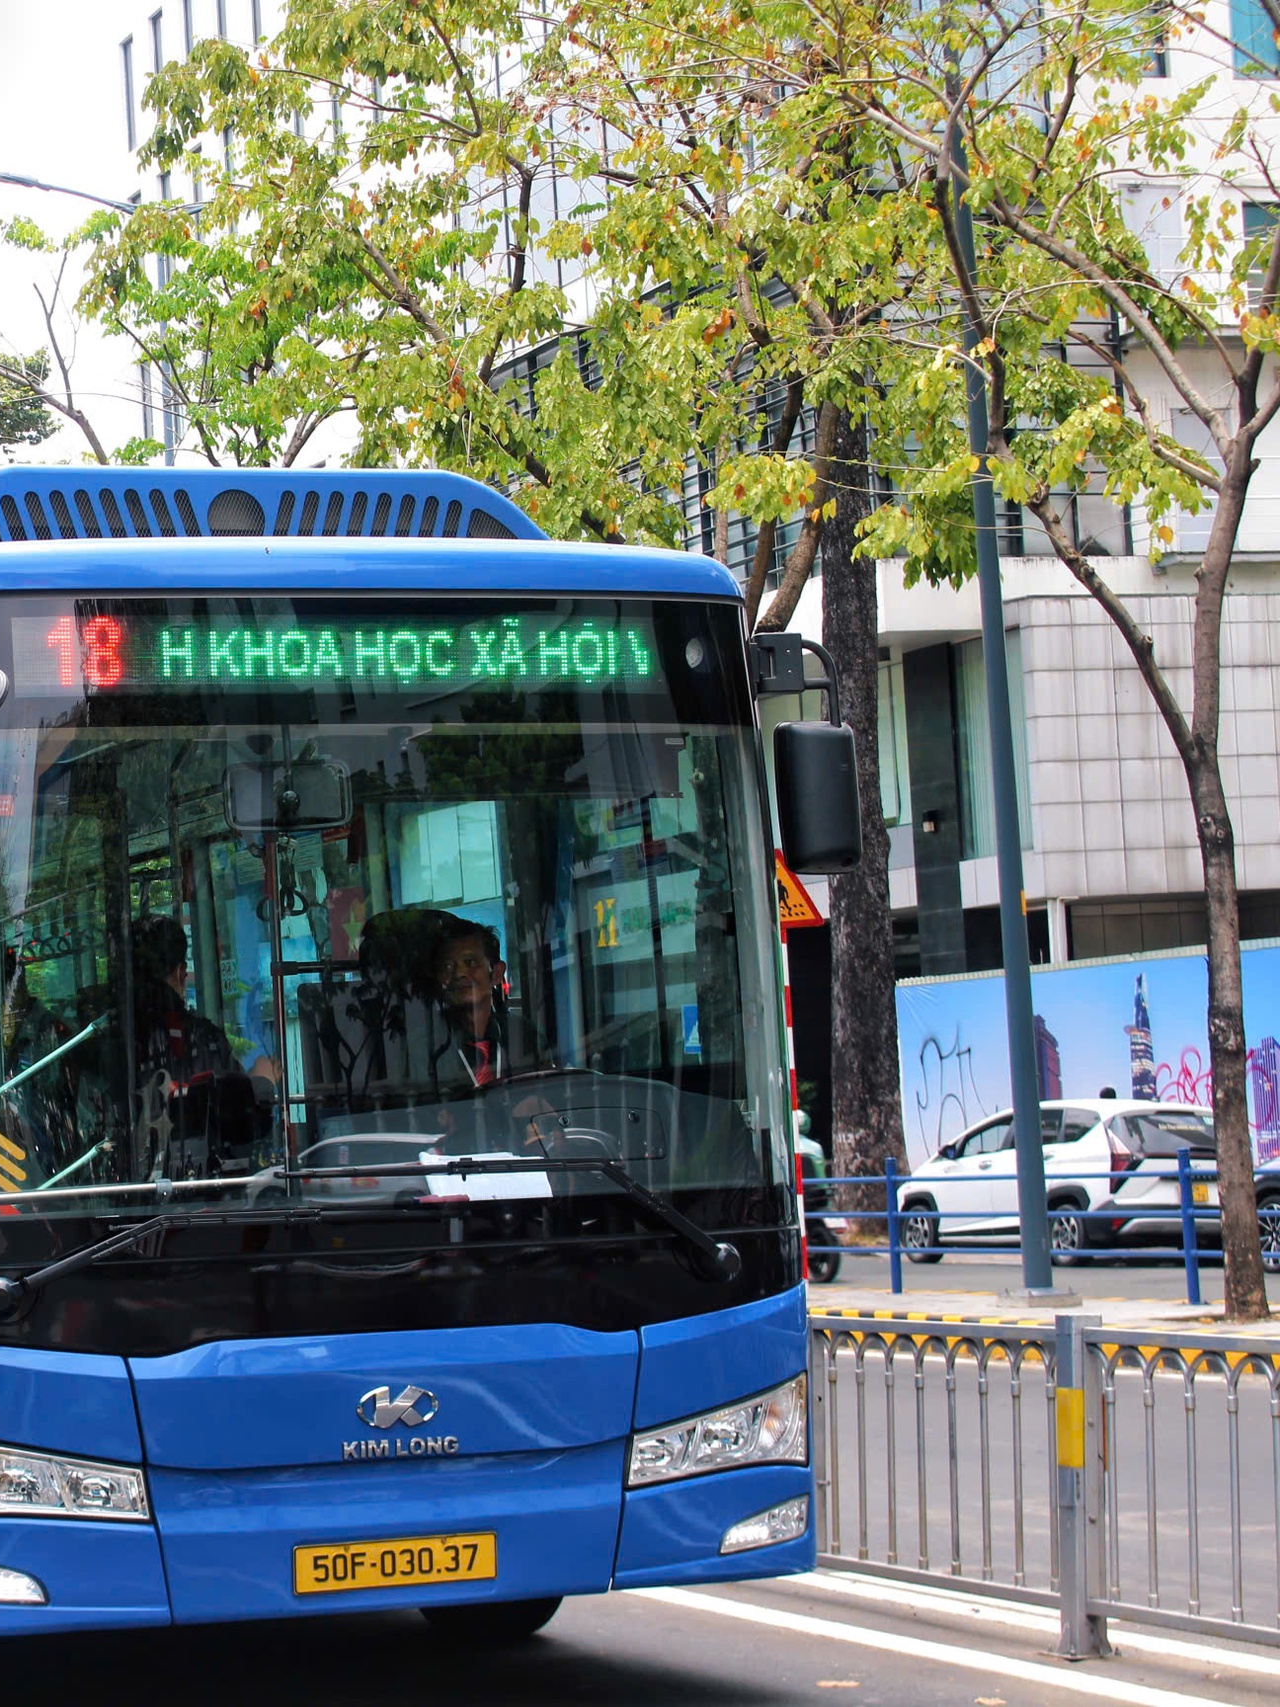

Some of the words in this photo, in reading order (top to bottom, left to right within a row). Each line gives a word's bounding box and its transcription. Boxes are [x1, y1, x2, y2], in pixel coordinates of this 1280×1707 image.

[46, 615, 122, 687] 18
[161, 630, 194, 677] H
[208, 630, 344, 677] KHOA
[354, 630, 454, 685] HỌC
[470, 618, 527, 677] XÃ
[538, 621, 616, 684] HỘI
[341, 1438, 389, 1461] KIM
[395, 1435, 460, 1457] LONG
[312, 1543, 479, 1583] 50F-030.37
